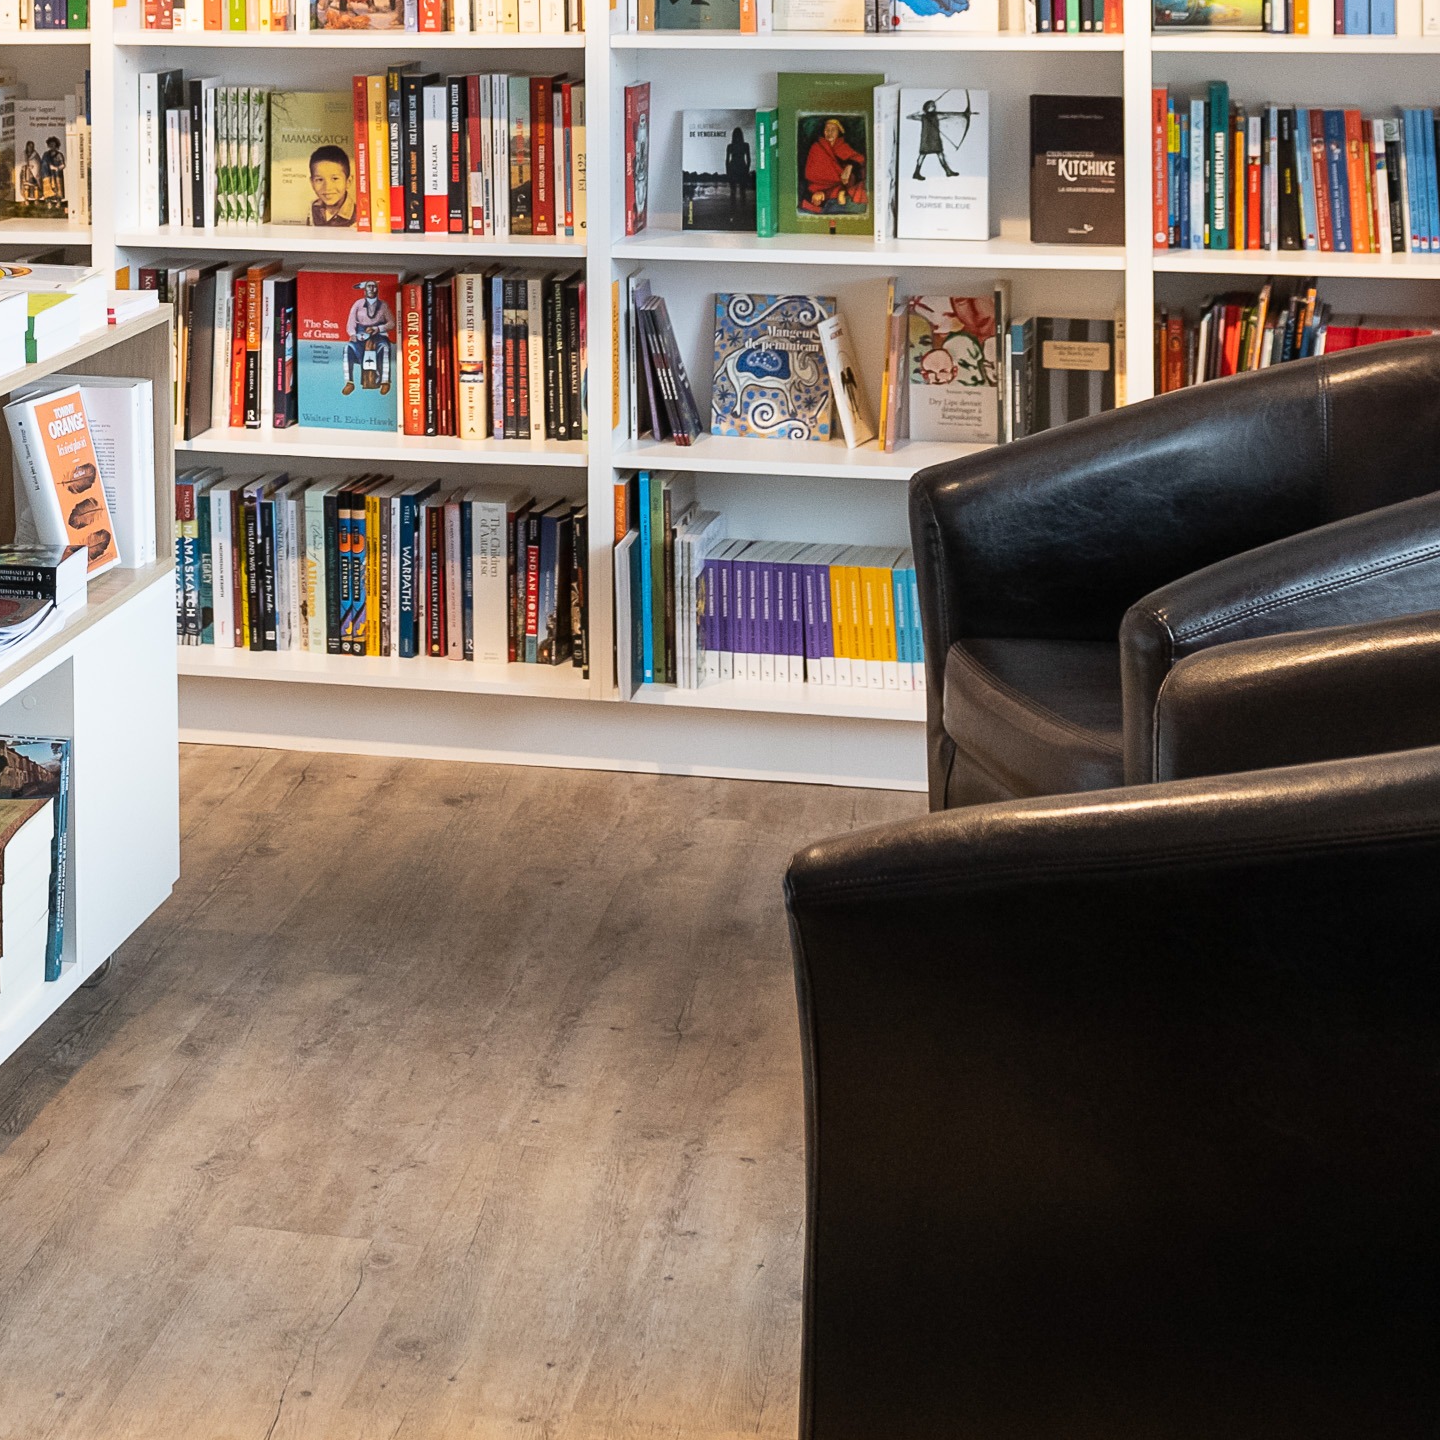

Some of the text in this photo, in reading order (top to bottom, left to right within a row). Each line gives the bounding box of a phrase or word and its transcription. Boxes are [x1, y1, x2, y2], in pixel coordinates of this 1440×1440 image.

[281, 133, 348, 144] MAMASKATCH
[1058, 158, 1116, 181] KITCHIKE
[915, 202, 971, 210] OURSE BLEUE
[303, 329, 339, 339] of Grass
[304, 319, 338, 329] The Sea
[407, 311, 418, 333] GIVE
[408, 348, 419, 375] SOME
[408, 377, 419, 406] TRUTH
[53, 402, 75, 418] TOMMY
[302, 413, 394, 427] Walter R. Echo-Hawk
[48, 413, 85, 440] ORANGE
[490, 517, 501, 577] The Children
[184, 525, 195, 617] MAMASKATCH
[201, 553, 211, 584] LEGACY
[402, 546, 411, 611] WARPATHS
[307, 560, 317, 617] Alliance
[528, 551, 538, 630] INDIAN HORSE
